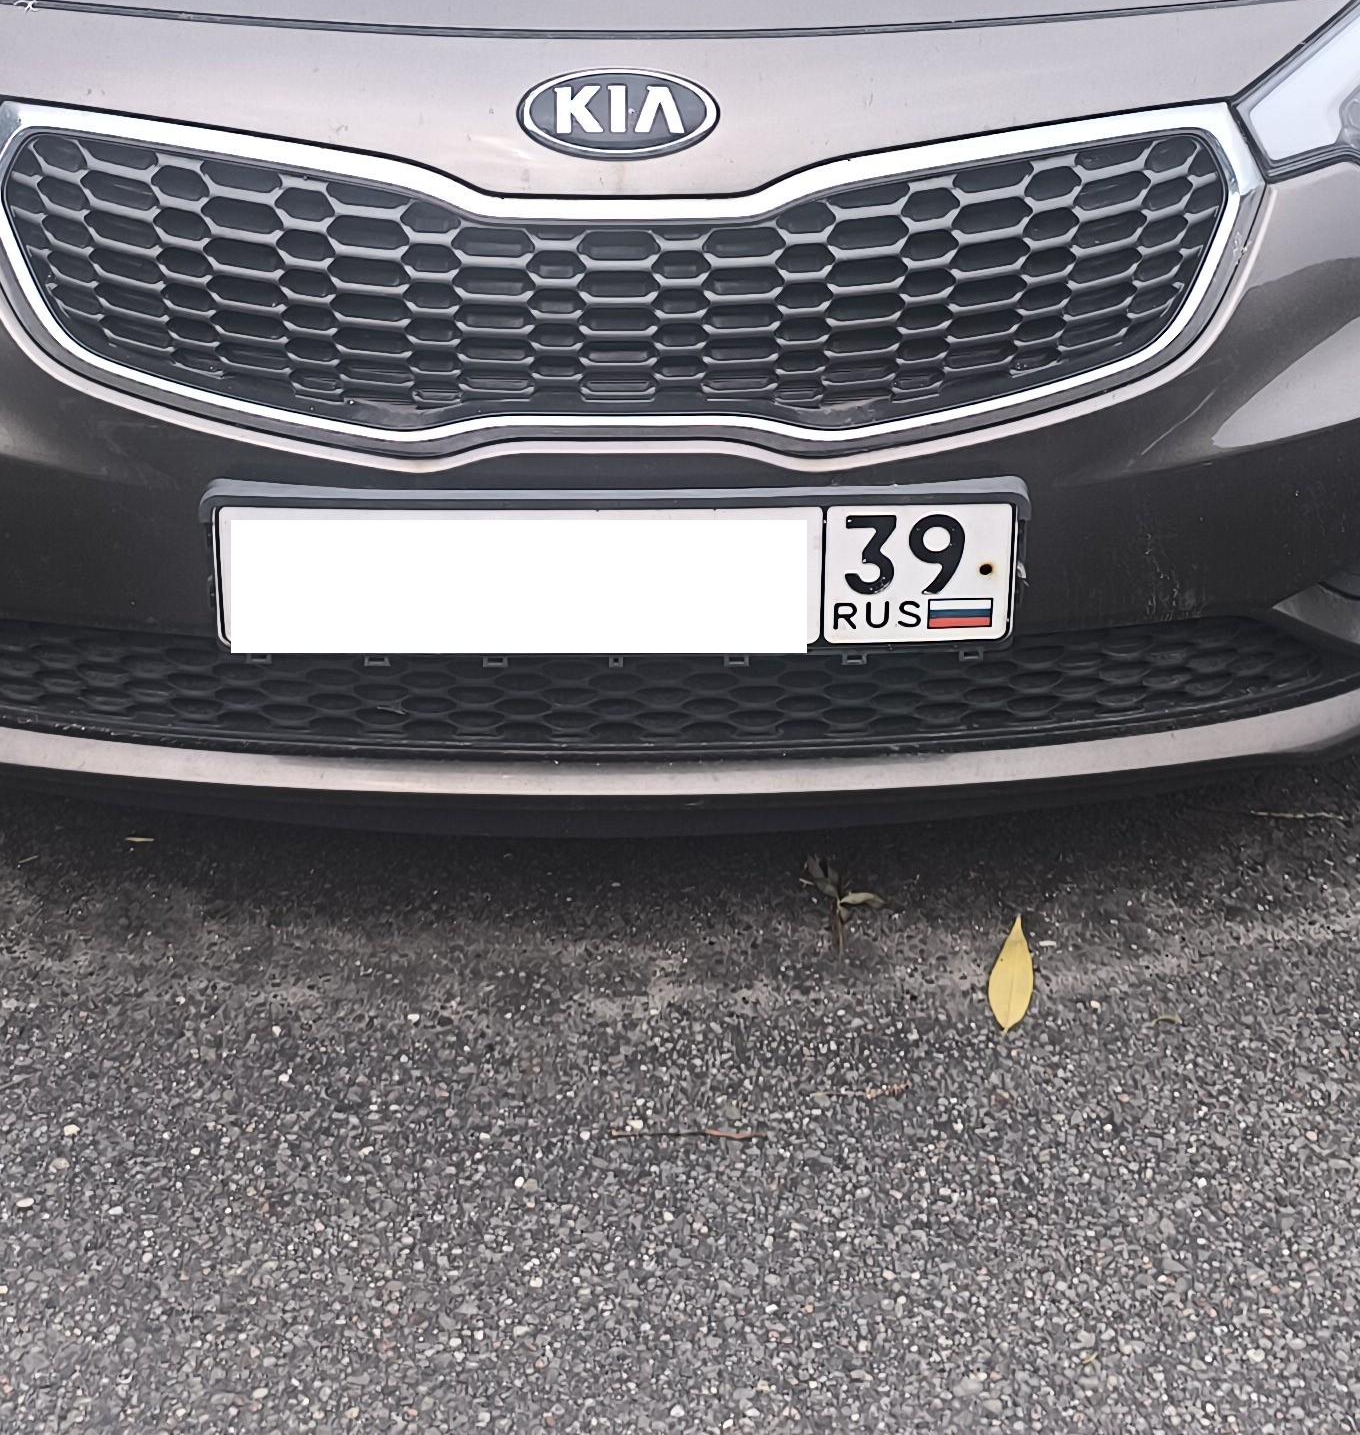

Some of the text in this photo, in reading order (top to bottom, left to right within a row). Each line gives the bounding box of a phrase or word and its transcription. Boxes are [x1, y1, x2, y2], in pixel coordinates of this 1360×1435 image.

[553, 84, 686, 135] KIA
[844, 513, 966, 596] 39
[832, 600, 922, 630] RUS
